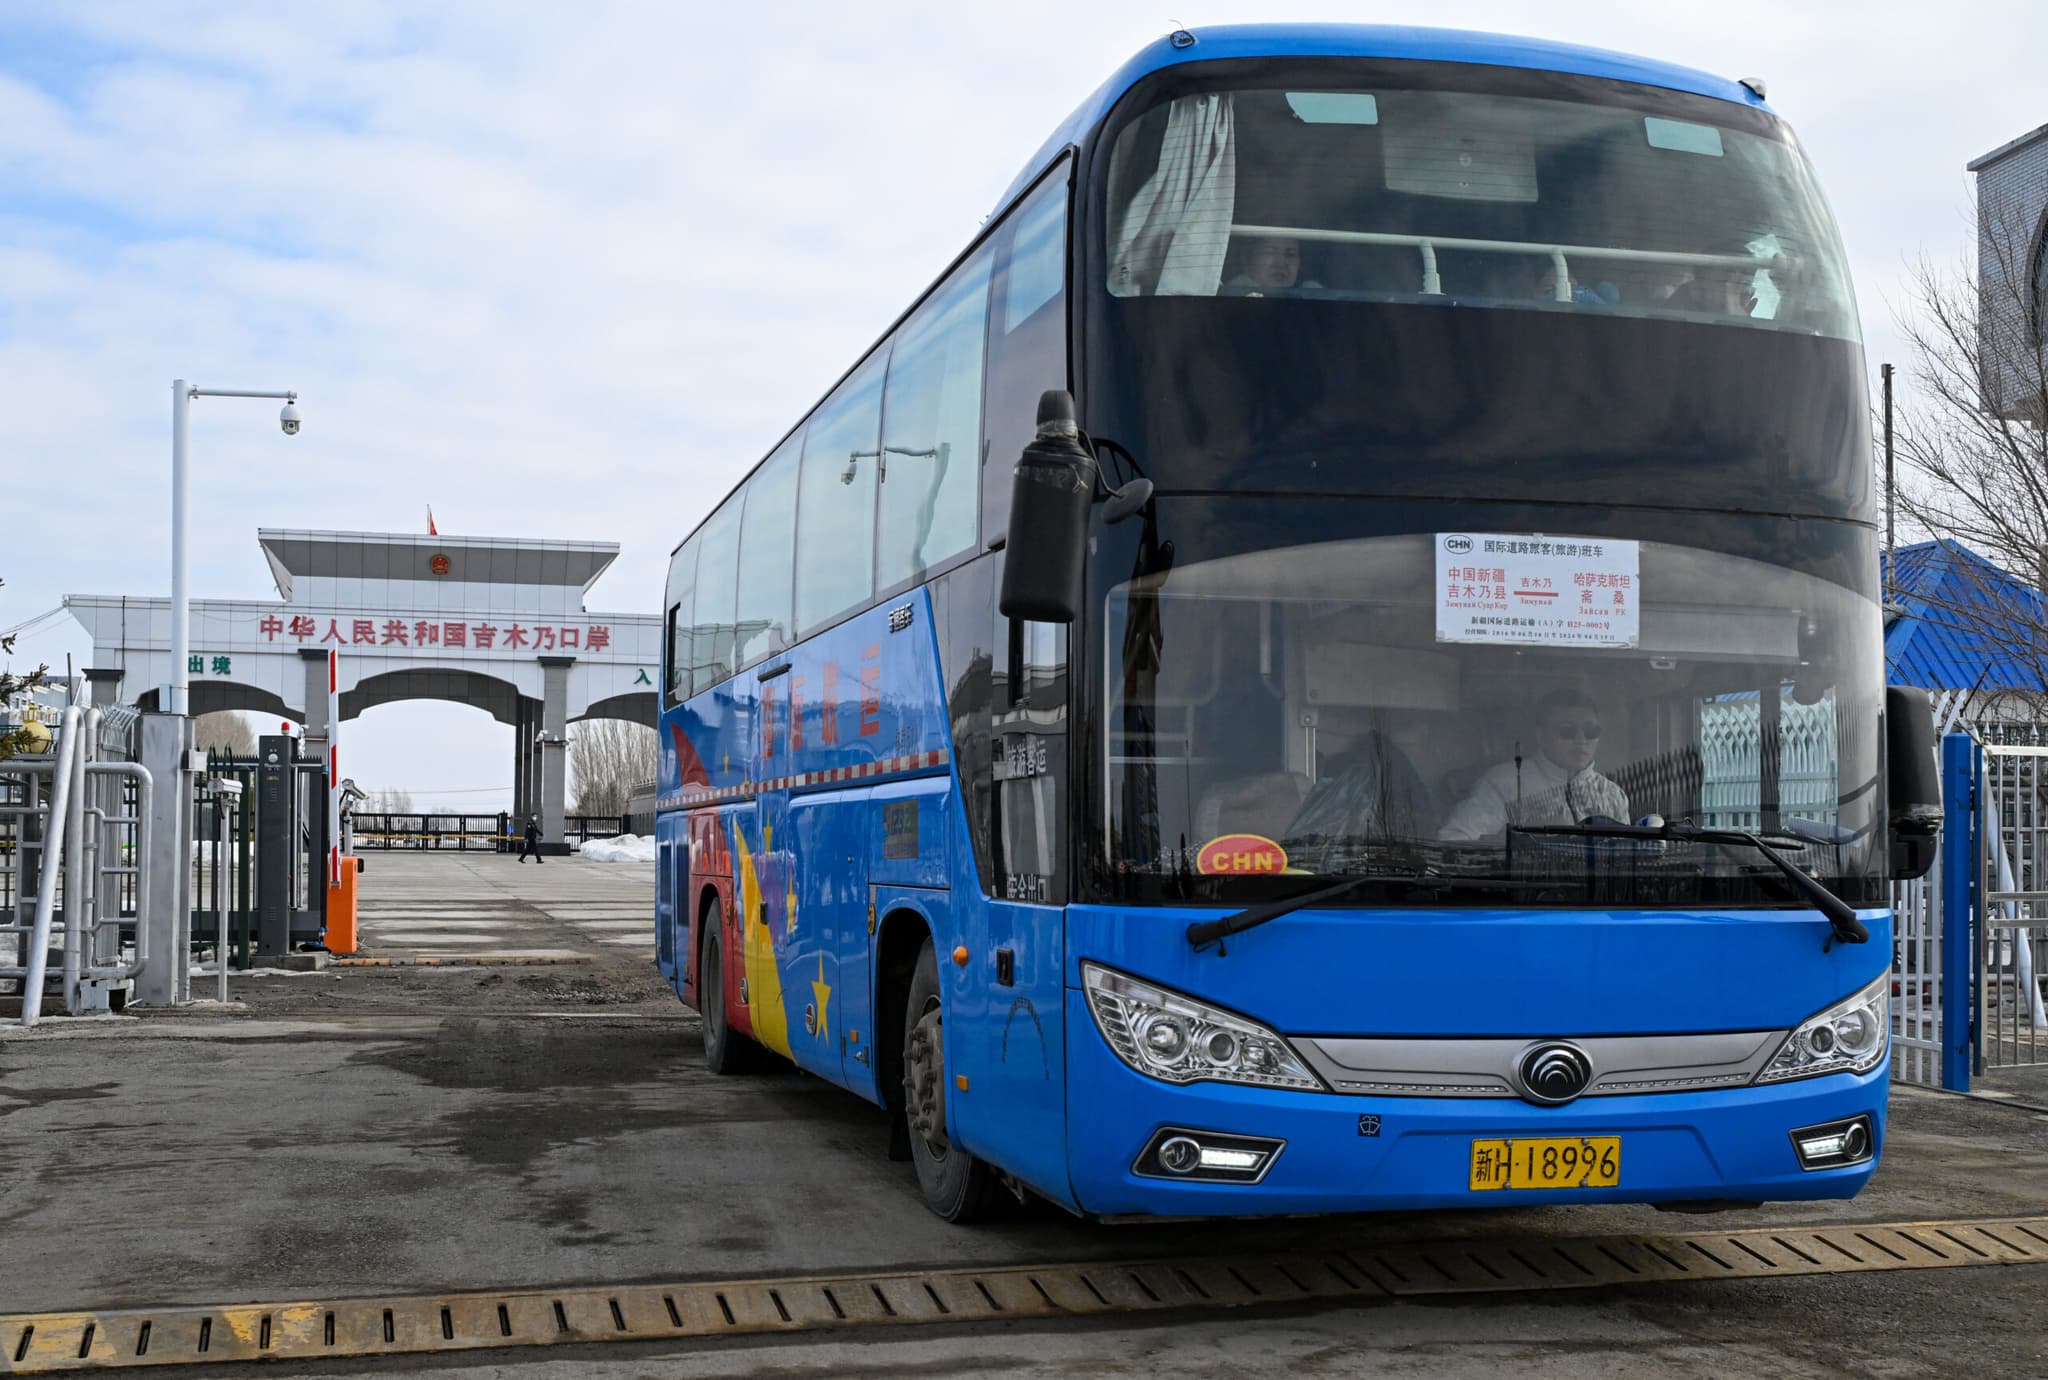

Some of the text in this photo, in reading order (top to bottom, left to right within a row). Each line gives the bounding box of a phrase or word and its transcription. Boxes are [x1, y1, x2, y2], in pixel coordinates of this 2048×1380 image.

[1447, 540, 1471, 550] CHN
[1484, 540, 1604, 557] 国际道路旅客(旅游)班车
[1448, 566, 1506, 583] 中国新疆
[1520, 576, 1552, 588] 吉木乃
[1573, 572, 1630, 588] 哈萨克斯坦
[1447, 584, 1507, 600] 吉木乃县
[259, 614, 611, 652] 中华人民共和国吉木乃口岸
[188, 655, 232, 675] 出境
[1212, 851, 1273, 872] CHN
[1007, 872, 1048, 903] 安全出口
